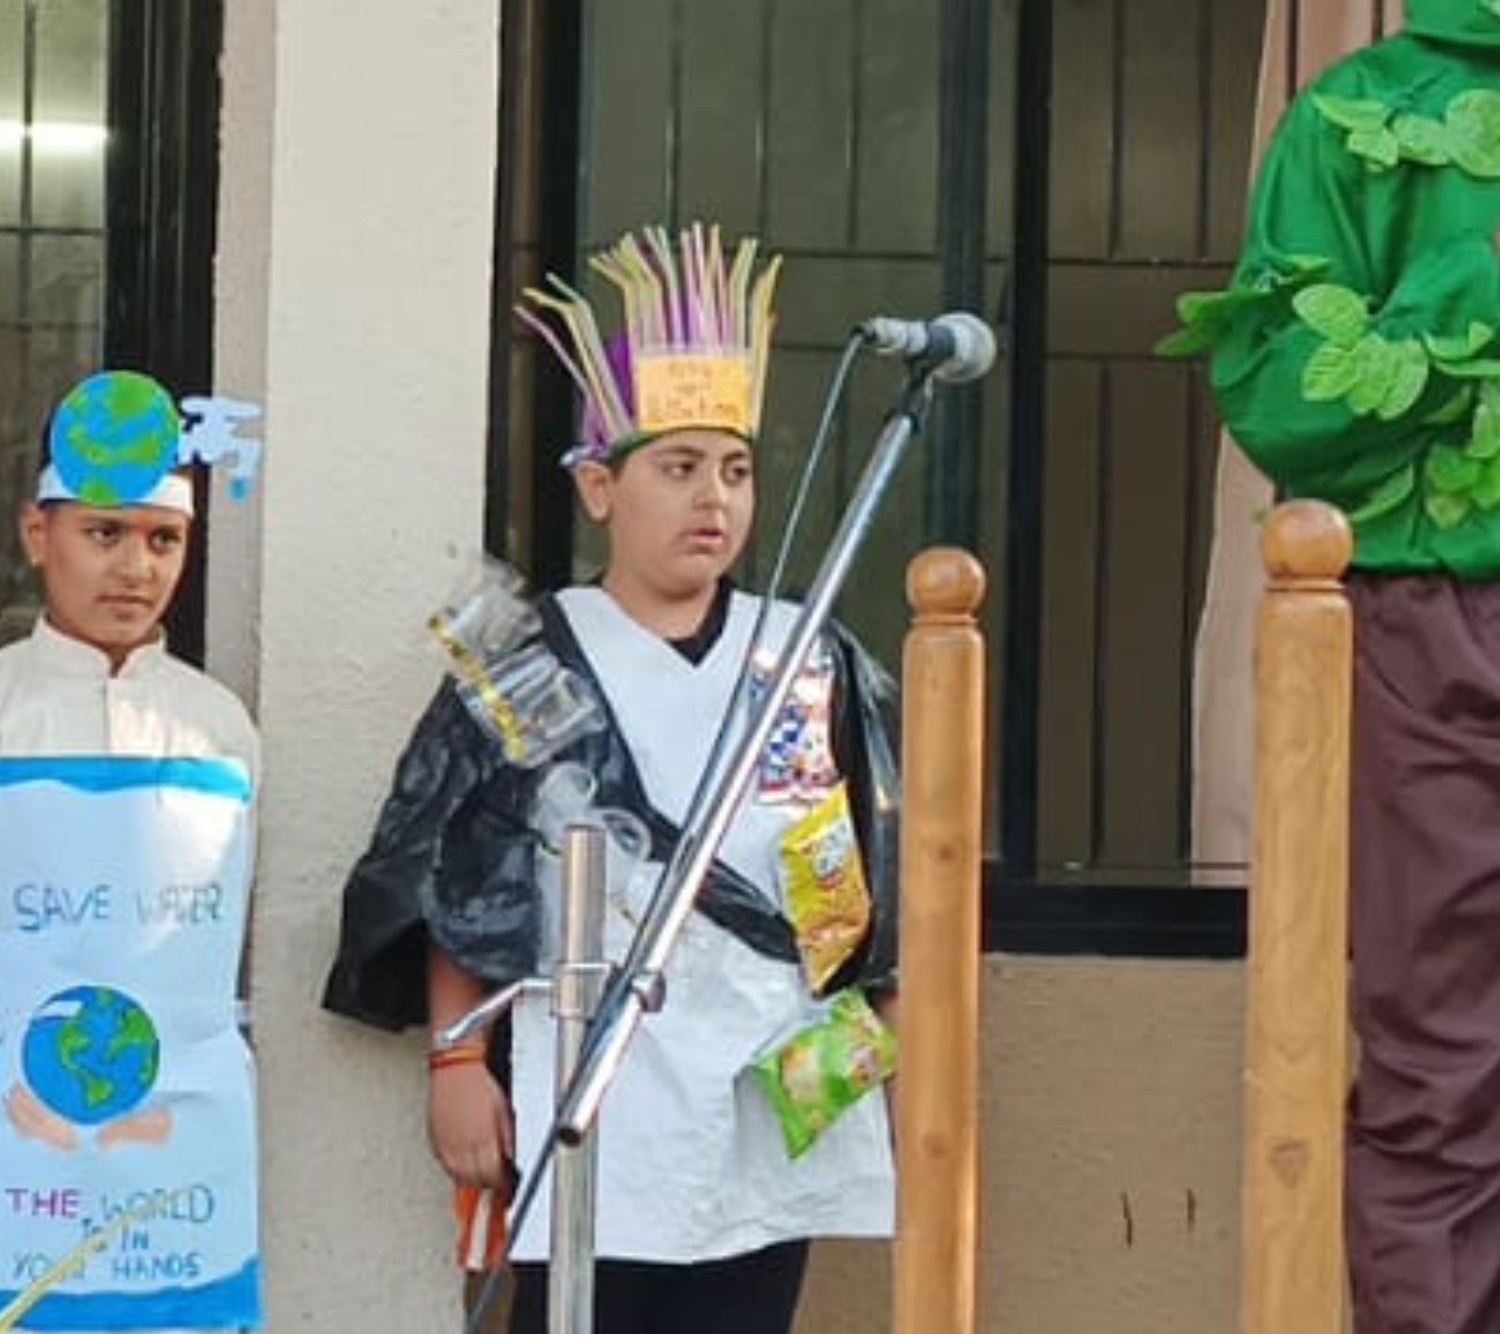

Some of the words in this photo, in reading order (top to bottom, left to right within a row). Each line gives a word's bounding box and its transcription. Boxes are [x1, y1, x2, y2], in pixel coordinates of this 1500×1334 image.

[12, 882, 112, 932] SAVE
[4, 1187, 83, 1218] THE
[12, 1250, 86, 1282] YO
